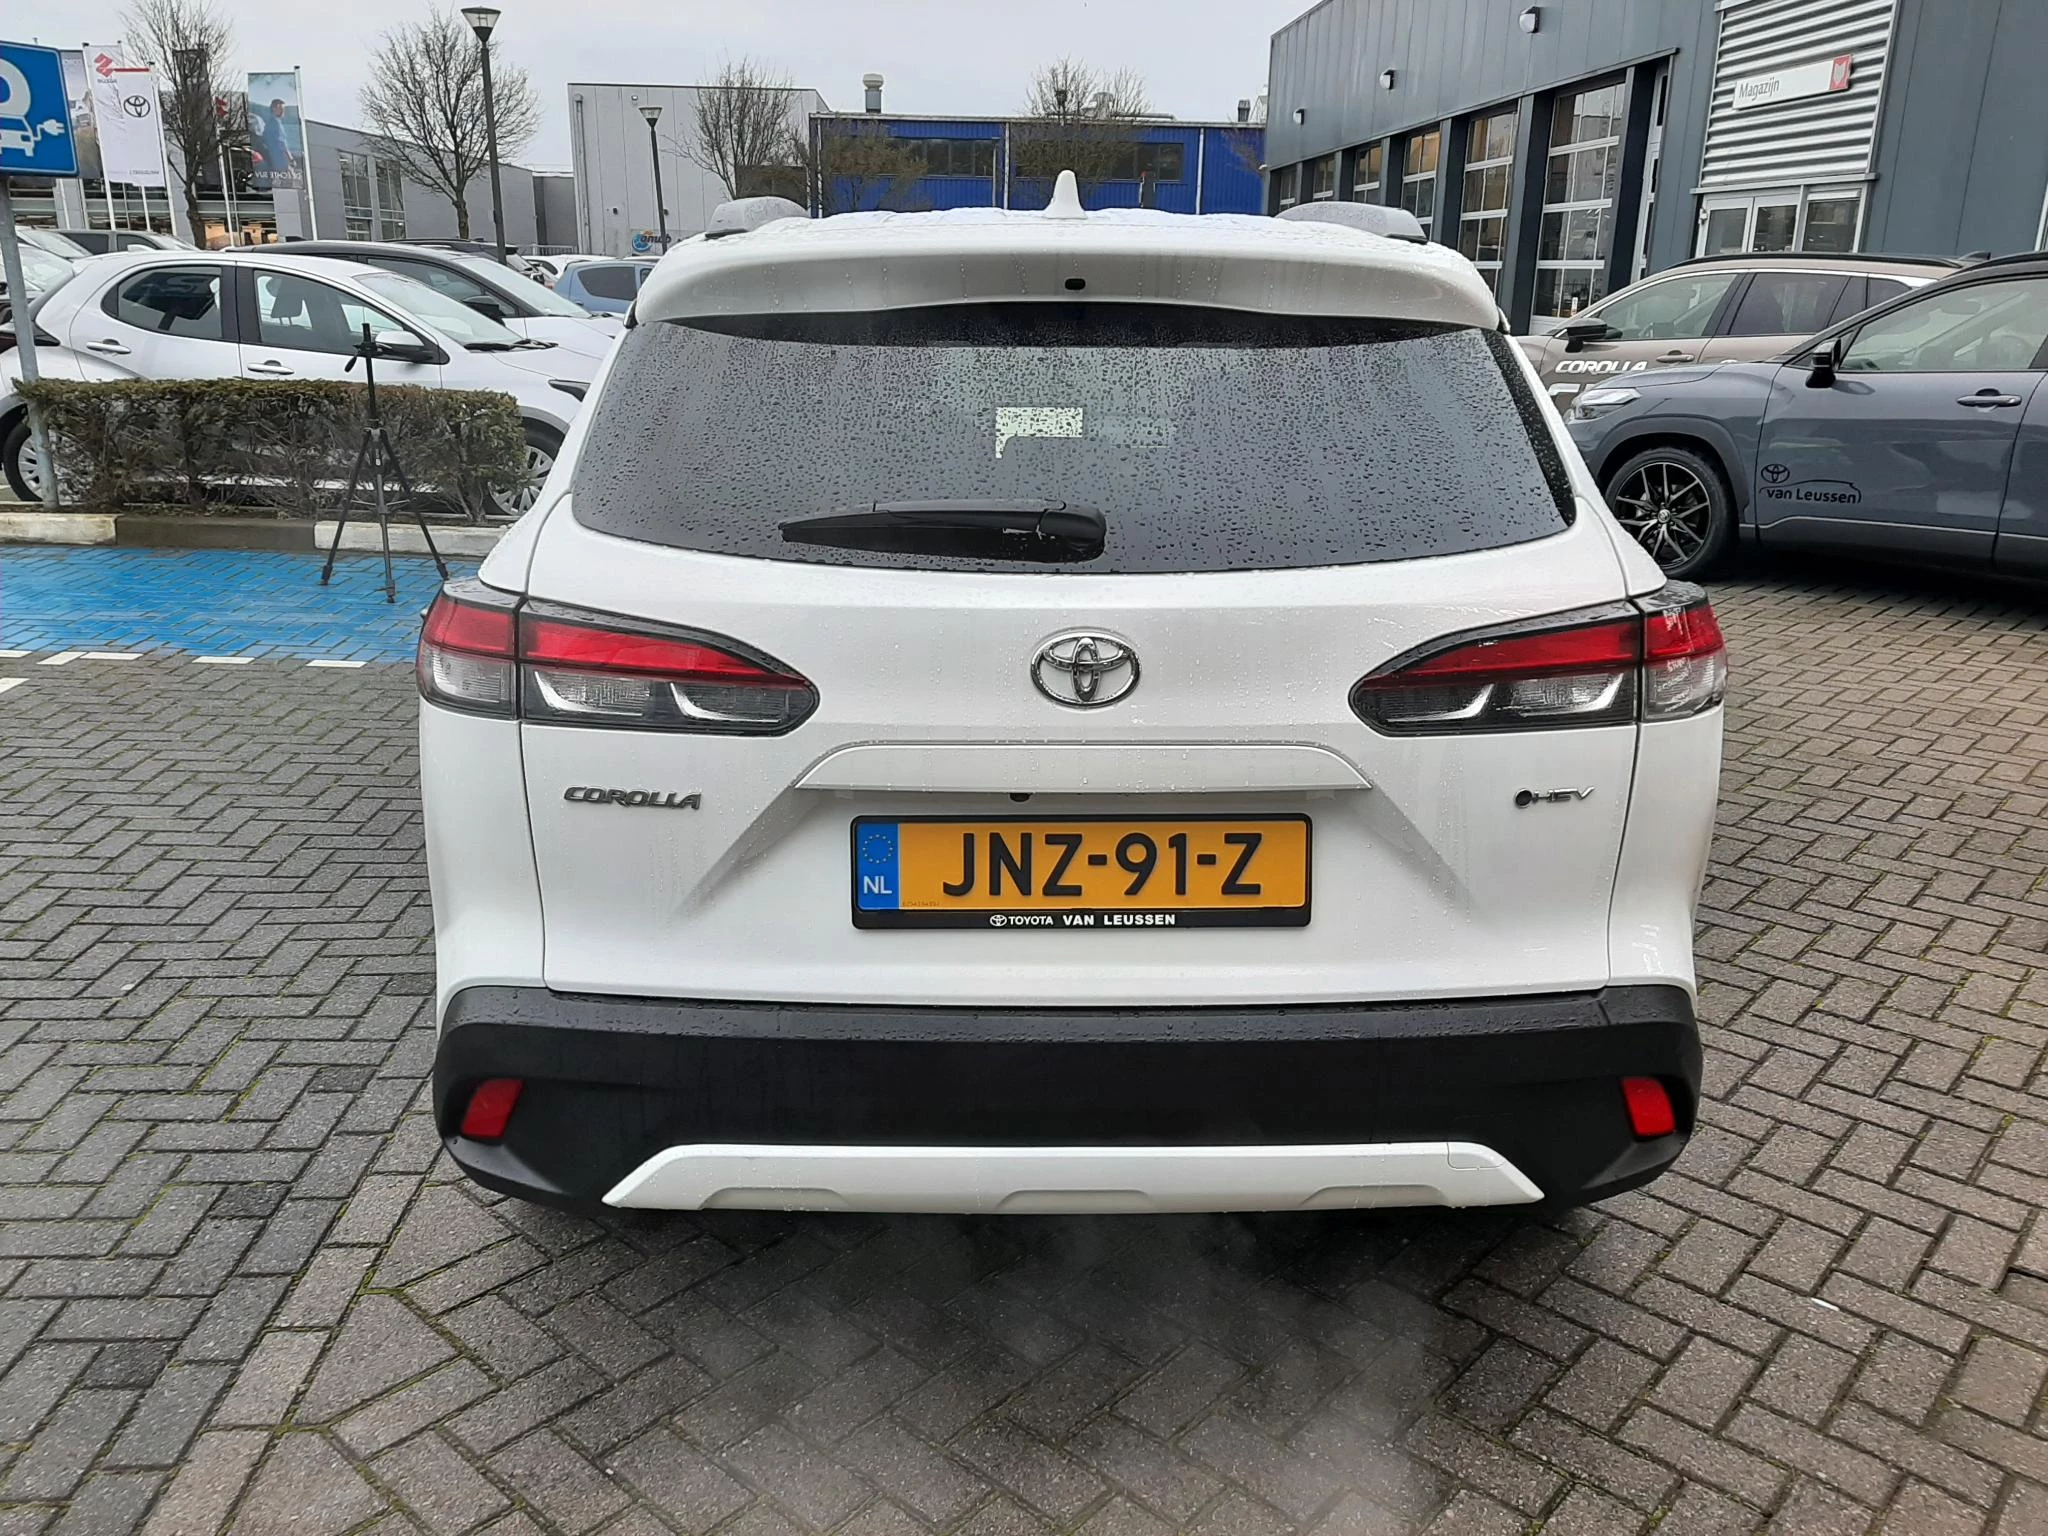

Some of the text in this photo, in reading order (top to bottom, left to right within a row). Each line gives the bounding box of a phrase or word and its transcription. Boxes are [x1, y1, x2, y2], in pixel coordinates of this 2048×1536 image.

[1739, 76, 1780, 101] Magazijn
[1555, 360, 1649, 376] COROLLA
[1766, 488, 1857, 504] van Leussen
[564, 786, 702, 810] COROLLA
[942, 832, 1263, 897] JNZ-91-Z
[863, 876, 892, 894] NL
[1008, 914, 1176, 926] TOYOTA VAN LEUSSEN
